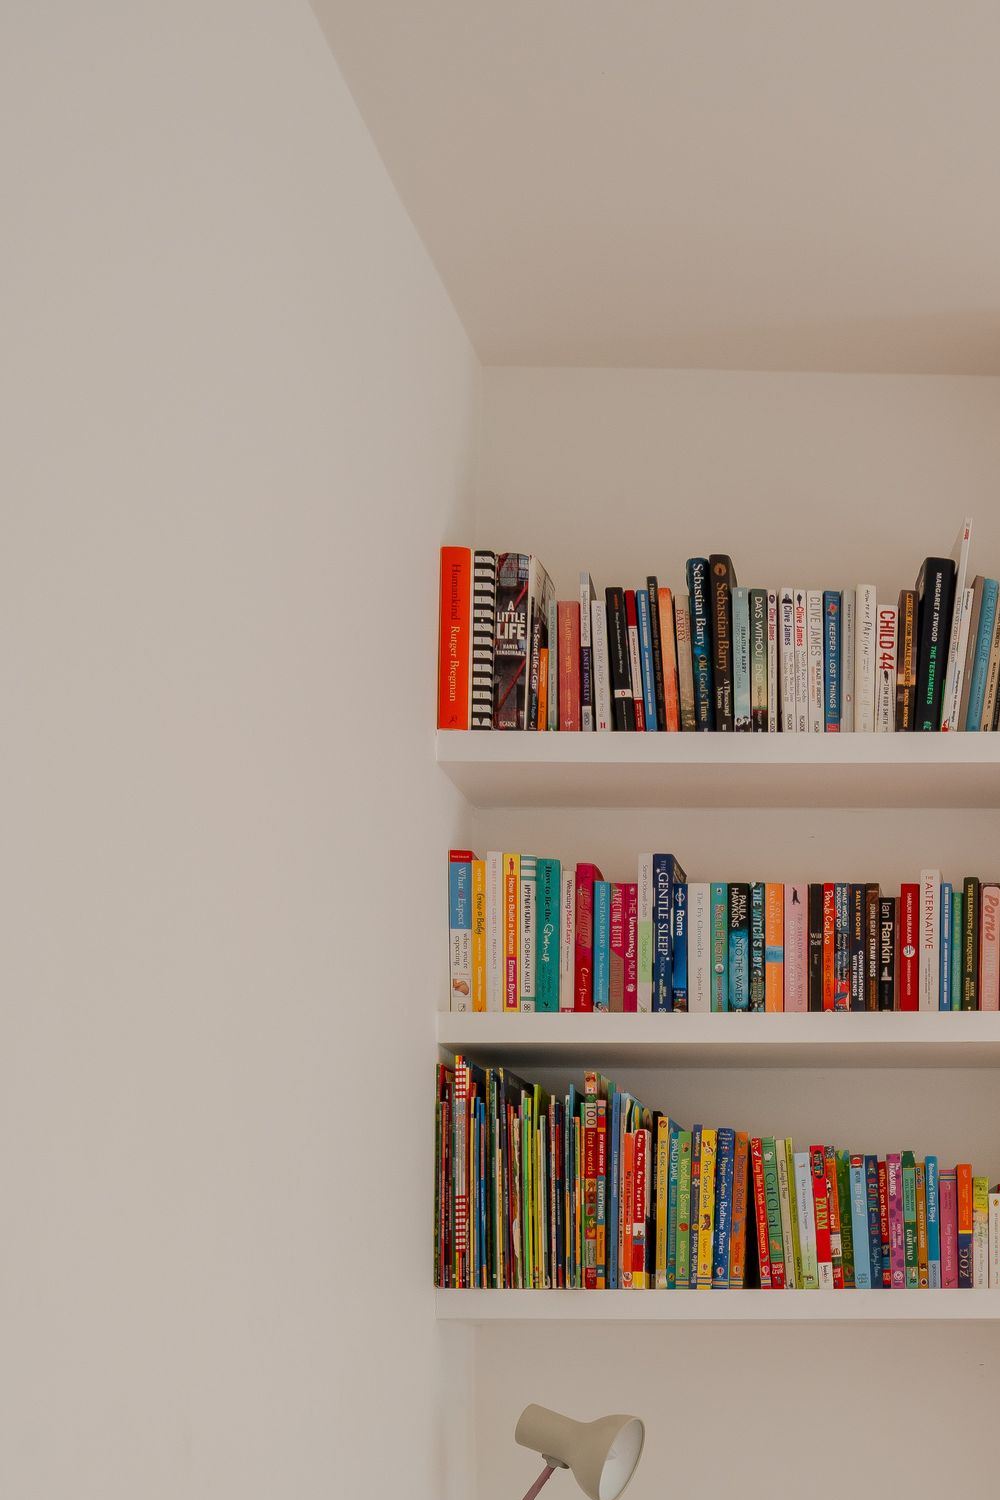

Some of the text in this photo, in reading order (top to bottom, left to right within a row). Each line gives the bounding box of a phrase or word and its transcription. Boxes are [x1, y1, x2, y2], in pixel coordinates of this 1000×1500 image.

[497, 612, 525, 623] LITTLE
[508, 601, 514, 611] A
[676, 609, 685, 643] BARRY
[783, 605, 792, 645] Clive James
[795, 606, 804, 646] Clive James
[809, 597, 821, 656] CLIVE JAMES
[448, 564, 461, 701] Humankind Rutger Bregman
[497, 623, 525, 639] LIFE
[693, 563, 709, 721] Sebastian Barry Old God's Time
[716, 583, 729, 672] Sebastian Barry
[754, 597, 764, 681] DAYS WITHOUT END
[879, 610, 895, 671] CHILD 44
[926, 572, 942, 704] MARGARET ATWOOD THE TESTAMENTS
[457, 867, 467, 889] What
[456, 898, 466, 925] Expect
[612, 888, 622, 948] EXPECTING BETTER
[658, 872, 668, 955] GENTLE SLEEP
[676, 910, 685, 936] Rome
[731, 888, 739, 927] HAWKINS
[752, 888, 764, 968] THE WITCH'S BOY
[824, 890, 833, 944] Paulo Coelho
[925, 882, 933, 949] ALTERNATIVE
[984, 895, 999, 942] Porno
[453, 935, 462, 966] expecting
[625, 917, 636, 958] Unmumsy
[881, 902, 893, 964] Ian Rankin
[628, 960, 636, 980] MUM
[734, 936, 743, 1003] INTO THE WATER
[586, 1105, 596, 1126] 100
[587, 1132, 595, 1175] first words
[597, 1181, 605, 1220] EVERYTHING
[680, 1158, 690, 1219] Woodland Sounds
[765, 1172, 778, 1228] Cat Chat
[879, 1169, 887, 1193] Who's
[880, 1195, 886, 1204] on
[718, 1201, 728, 1254] Bedtime Stories
[815, 1197, 828, 1230] FARM
[880, 1218, 888, 1236] Loo?
